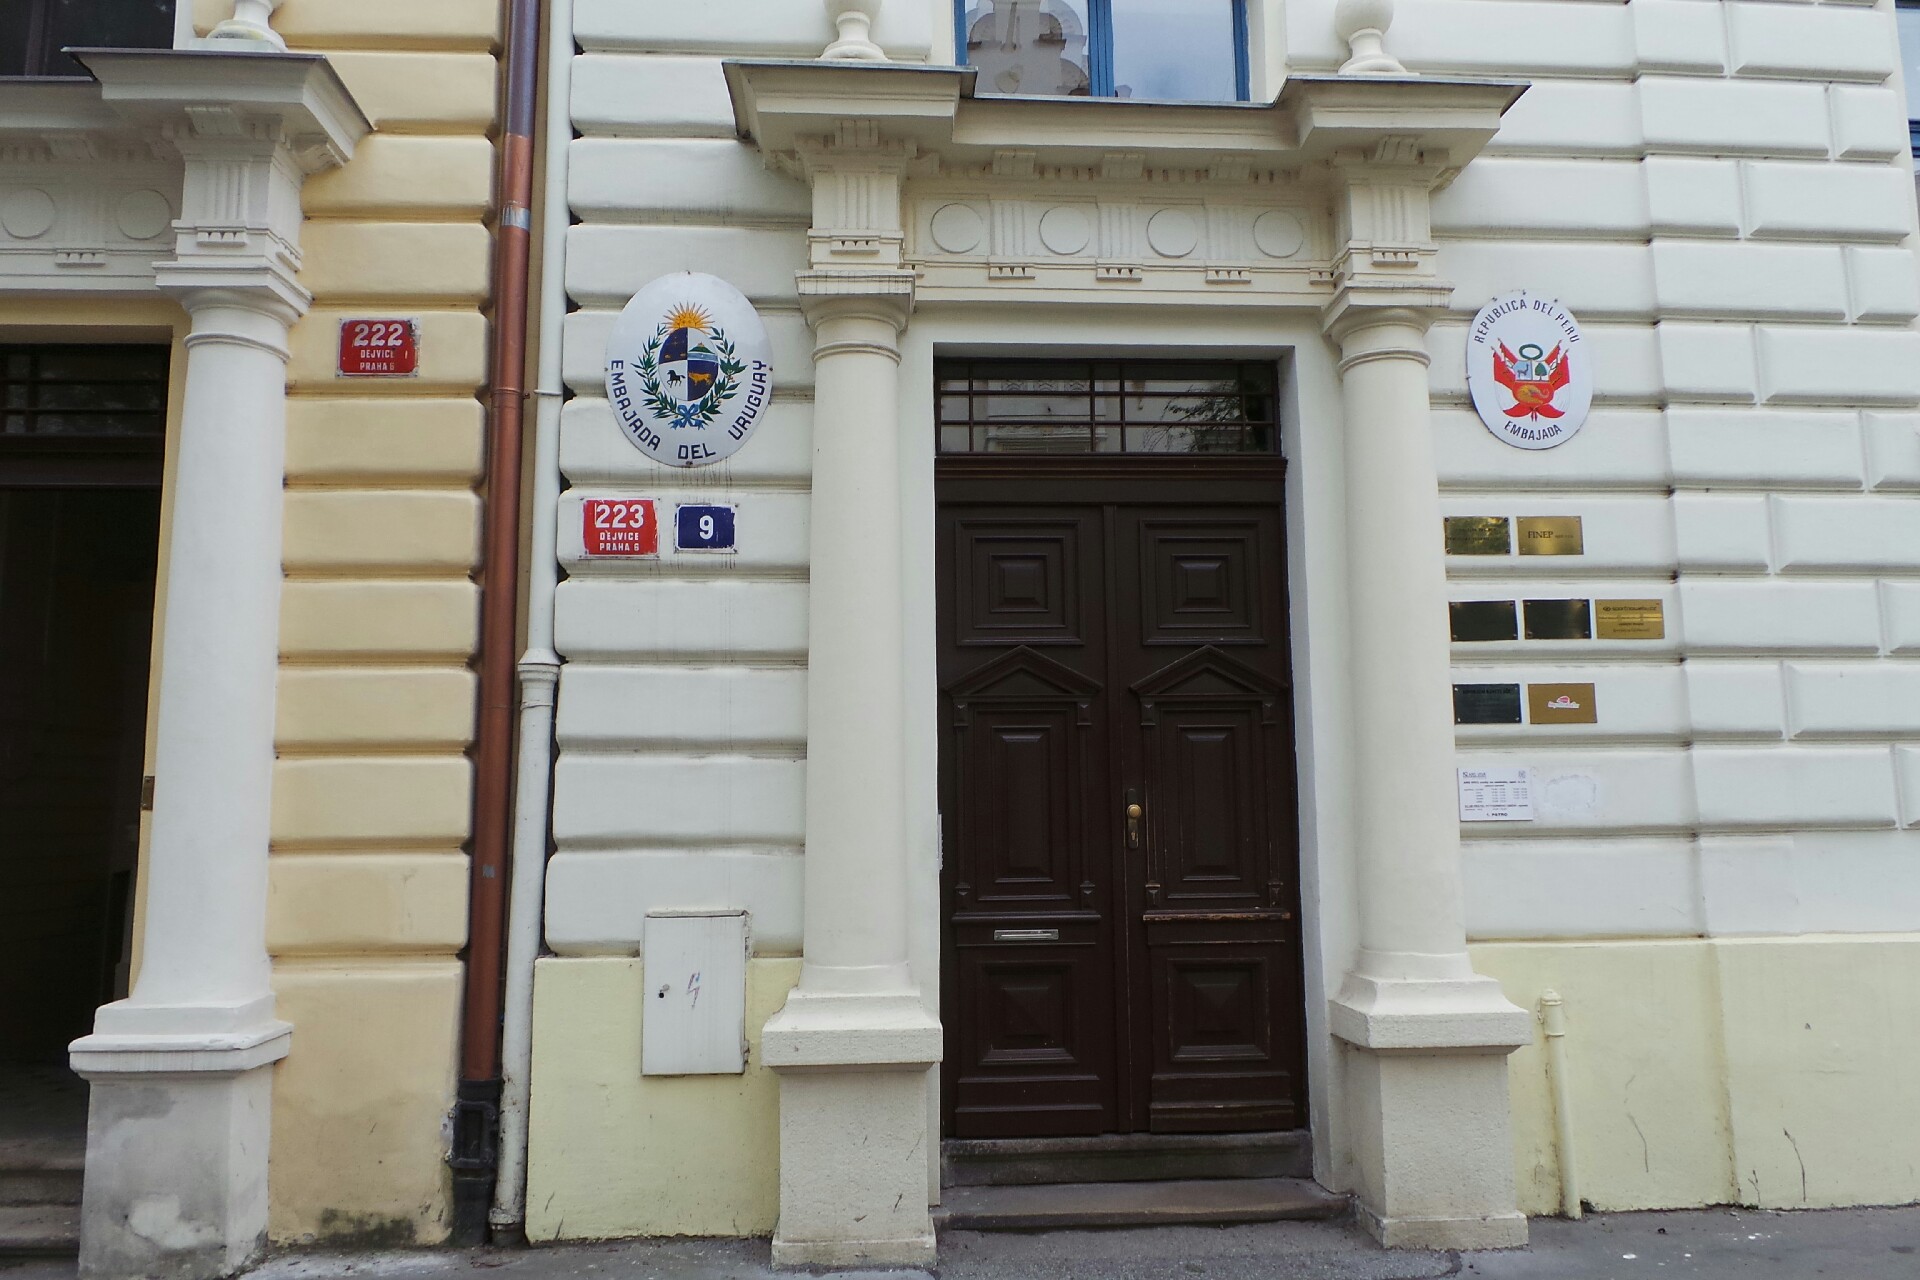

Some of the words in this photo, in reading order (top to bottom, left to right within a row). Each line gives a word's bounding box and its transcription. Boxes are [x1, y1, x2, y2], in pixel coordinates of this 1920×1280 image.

[1474, 298, 1527, 344] REPUBLICA
[1533, 300, 1553, 316] DEL
[1555, 313, 1580, 343] PERU
[354, 323, 403, 346] 222
[360, 362, 387, 371] PRAHA
[610, 359, 662, 452] EMBAJADA
[677, 442, 716, 460] DEL
[727, 360, 768, 442] URUGUAY
[1504, 420, 1562, 441] EMBAJADA
[595, 504, 644, 529] 223
[699, 515, 714, 540] 9
[599, 532, 639, 541] DEJVICE
[1528, 530, 1554, 539] FINEP
[599, 542, 630, 551] PRAHA
[633, 542, 640, 551] 6
